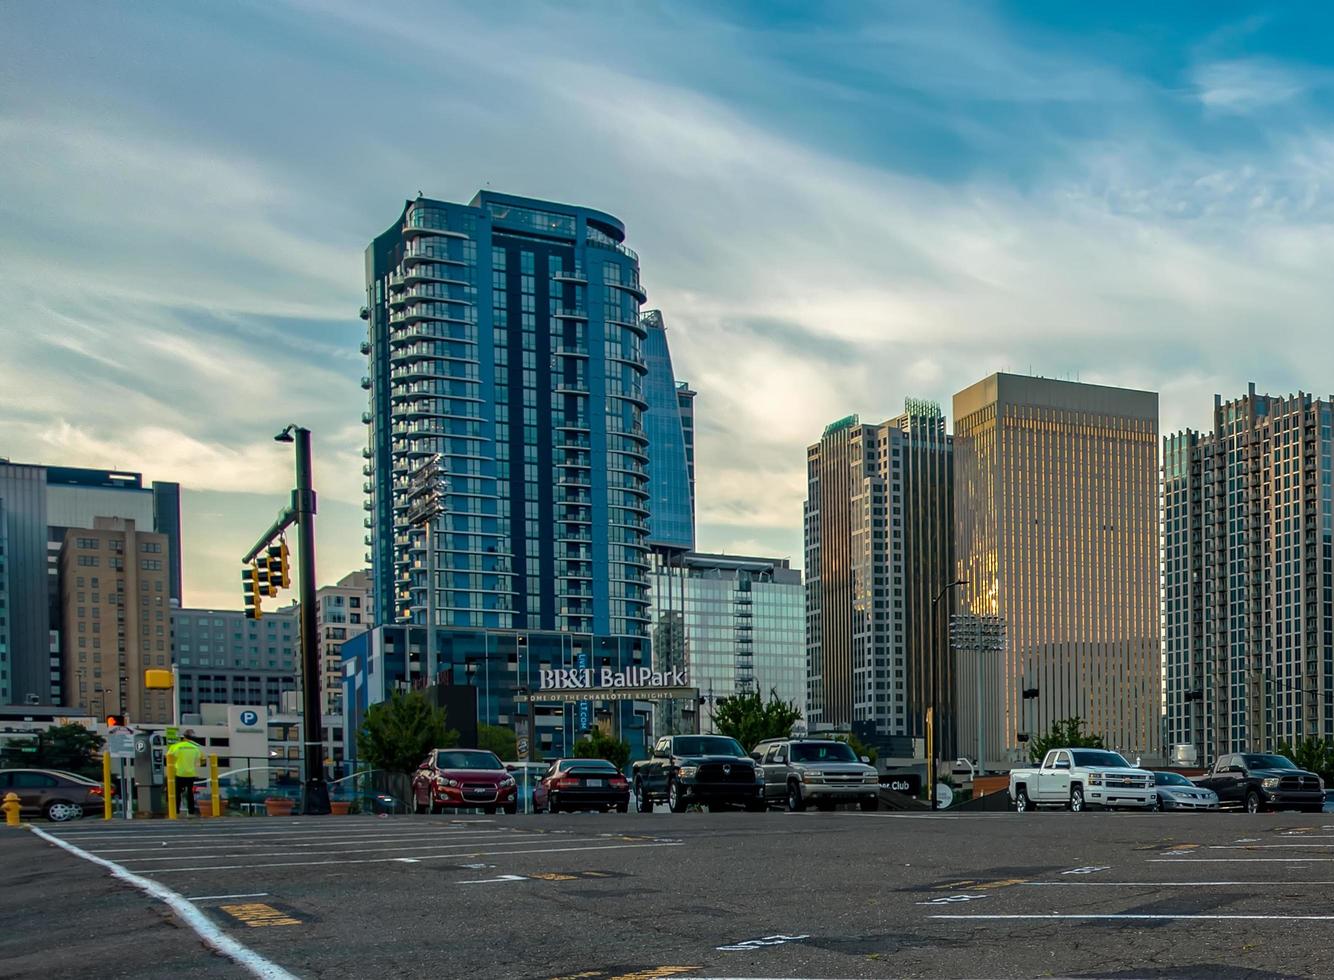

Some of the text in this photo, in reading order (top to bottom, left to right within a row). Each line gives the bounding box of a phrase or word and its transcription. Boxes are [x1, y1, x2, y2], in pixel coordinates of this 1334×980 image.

[539, 664, 685, 689] BB&T BallPark
[583, 693, 632, 701] CHARLOTTE
[635, 692, 673, 700] KNIGHTS
[891, 781, 910, 790] Club
